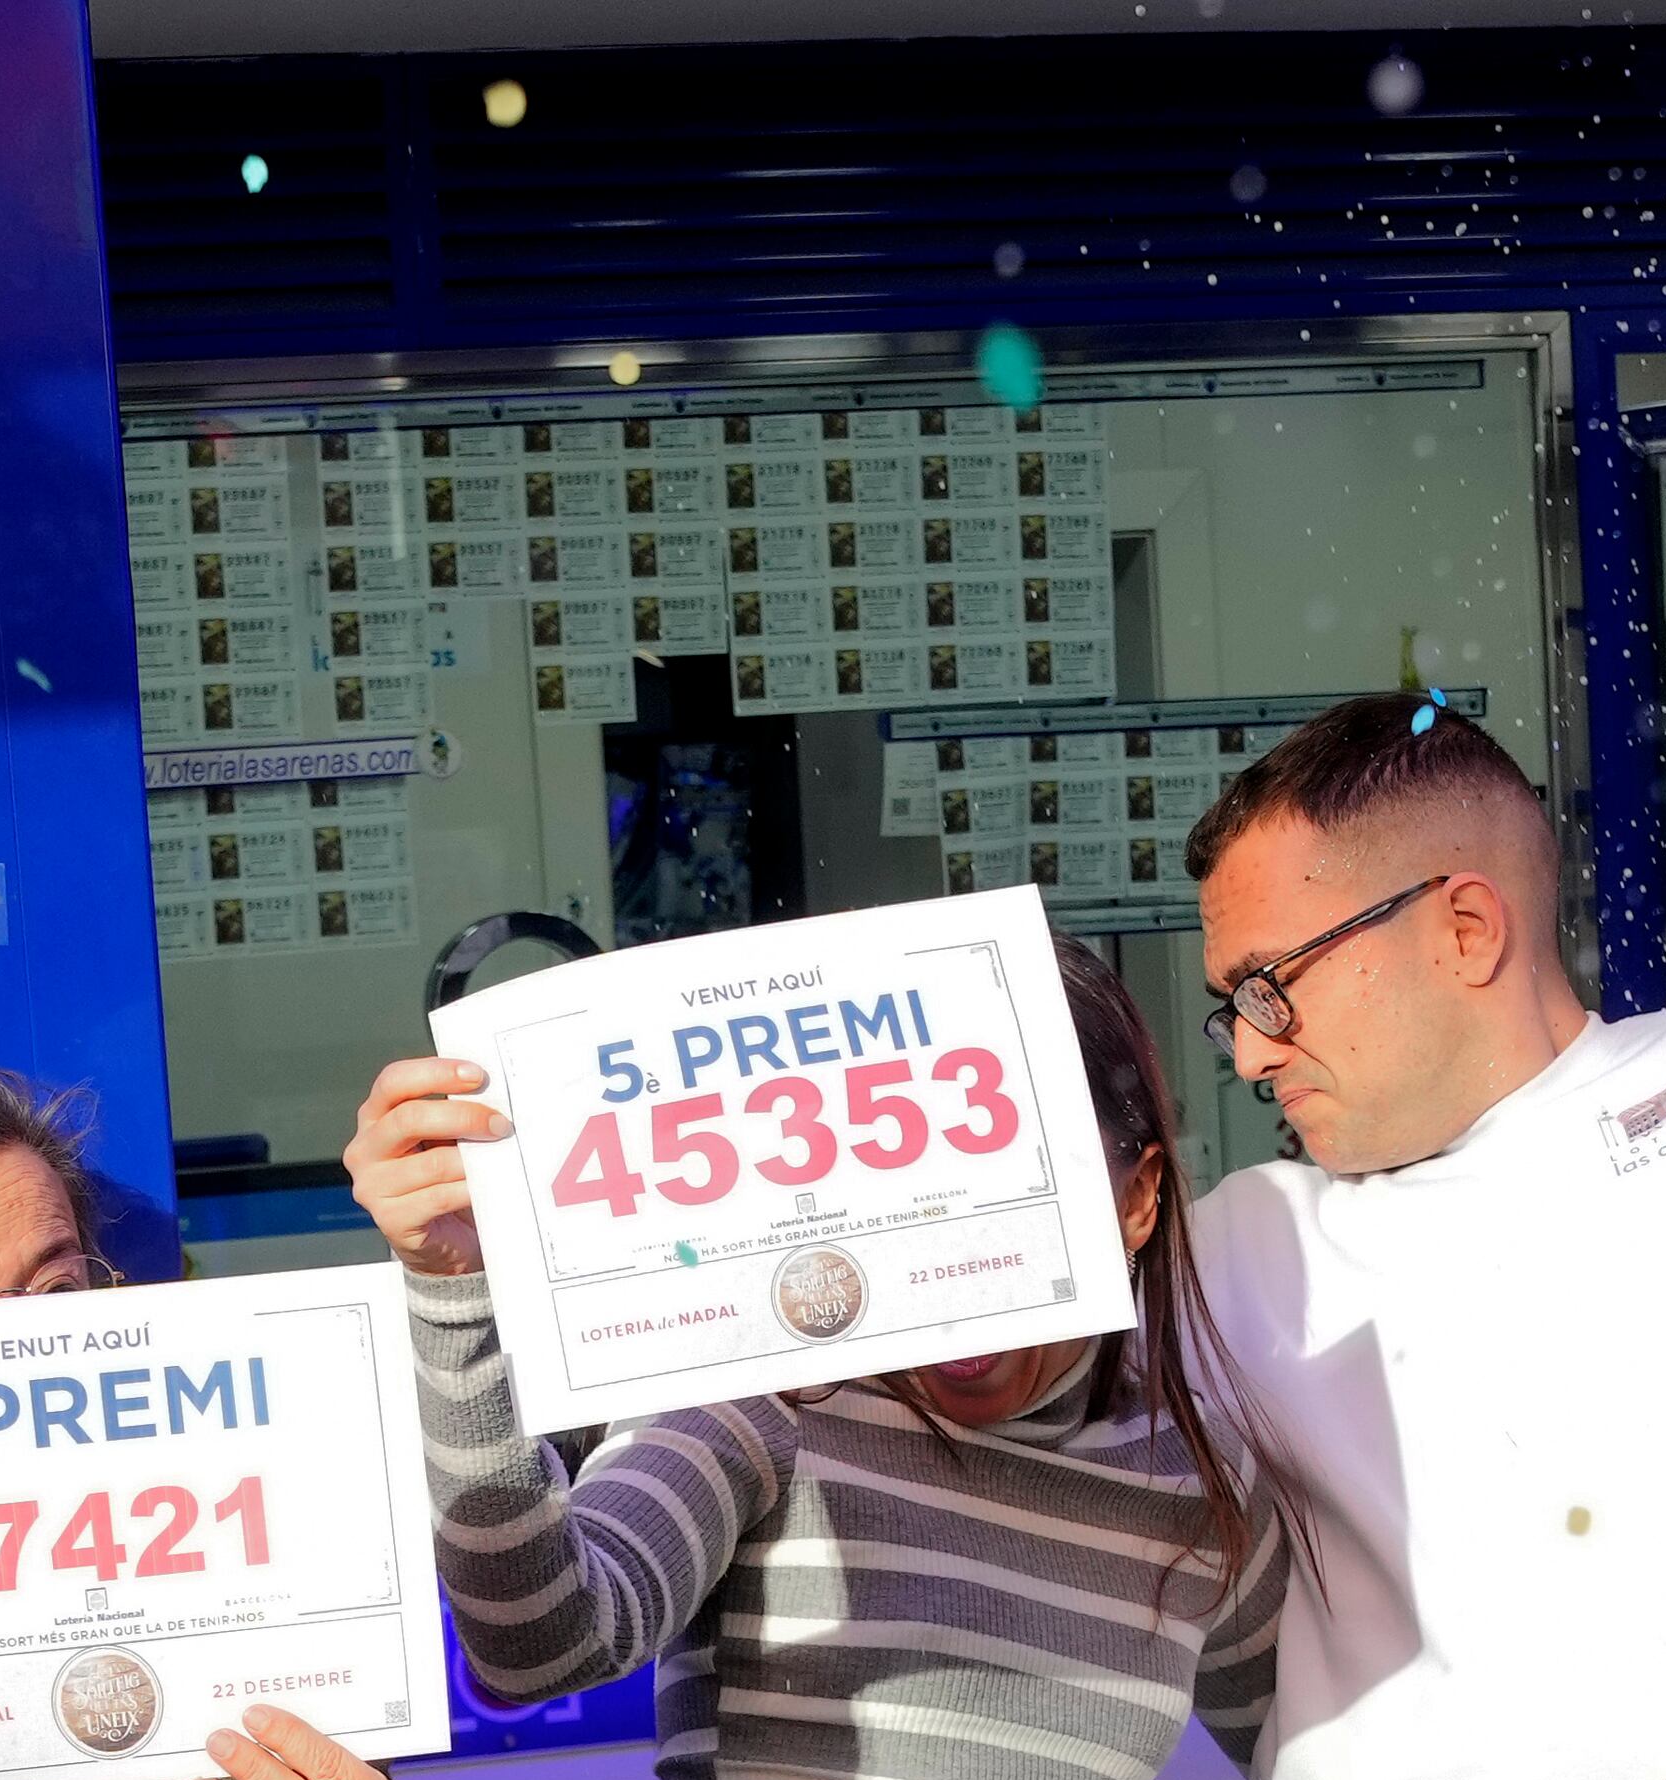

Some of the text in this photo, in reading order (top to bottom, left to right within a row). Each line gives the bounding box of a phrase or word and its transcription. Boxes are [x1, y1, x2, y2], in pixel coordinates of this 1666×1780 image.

[681, 966, 823, 1007] VENUT AQUÍ
[597, 989, 932, 1103] 5è PREMI
[551, 1047, 1019, 1218] 45353
[1613, 1155, 1651, 1177] las
[909, 1253, 1024, 1284] 22 DESEMBRE
[83, 1322, 150, 1352] AQUÍ
[581, 1304, 739, 1343] LOTERIA de NADAL
[54, 1608, 145, 1626] Lotería Nacional
[213, 1670, 353, 1698] 22 DESEMBRE
